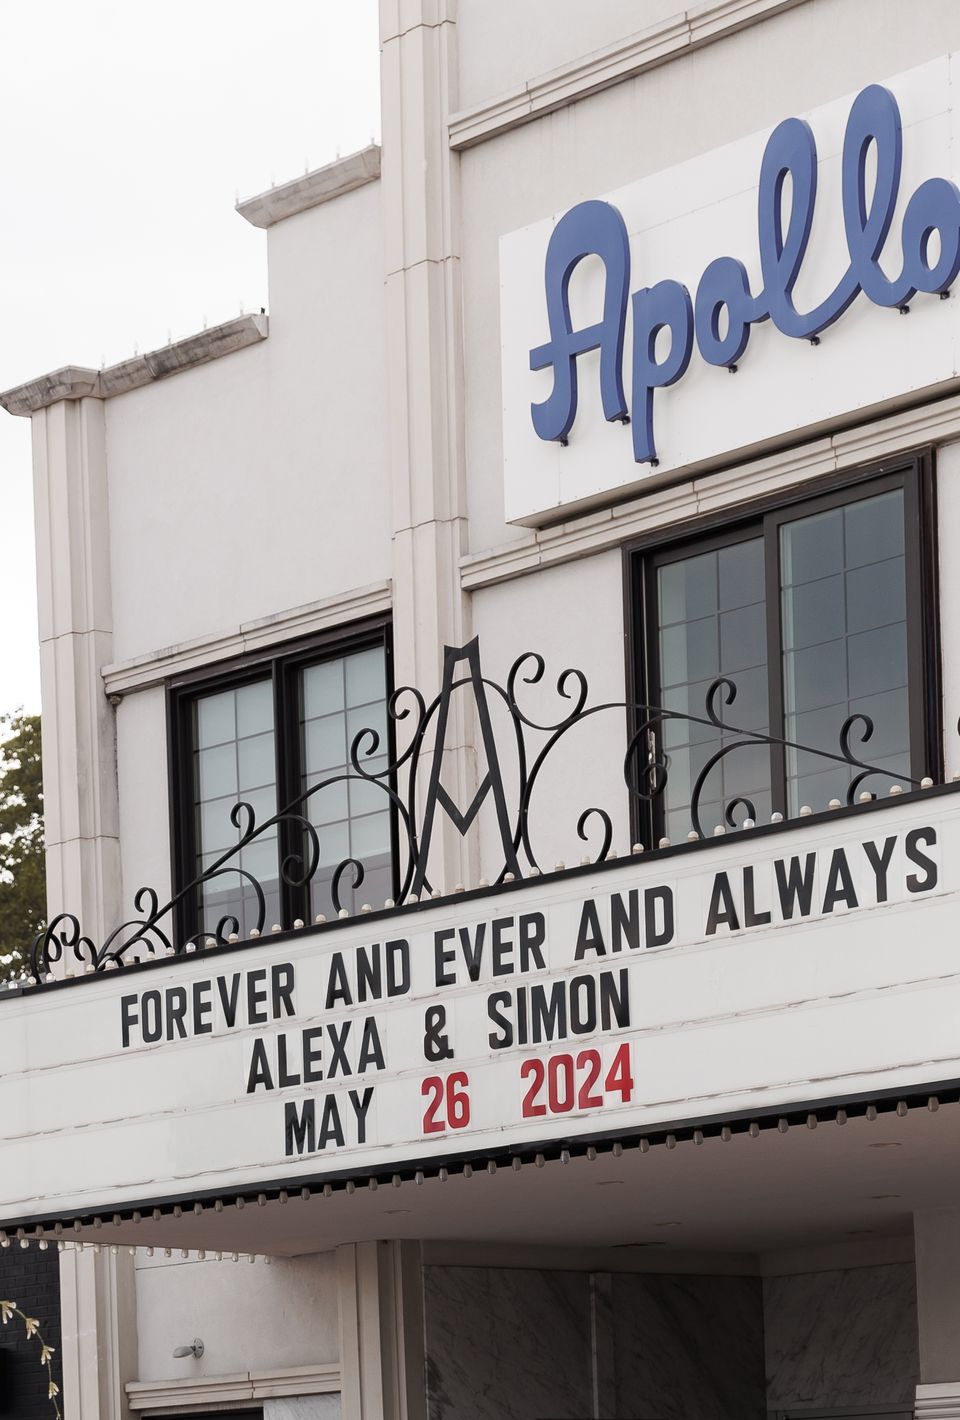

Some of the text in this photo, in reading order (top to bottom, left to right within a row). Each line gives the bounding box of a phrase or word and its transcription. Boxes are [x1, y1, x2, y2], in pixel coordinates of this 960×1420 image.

[529, 84, 960, 463] Apollo
[121, 826, 938, 1048] FOREVER AND EVER AND ALWAYS
[246, 968, 631, 1094] ALEXA & SIMON
[285, 1042, 634, 1157] MAY 26 2024
